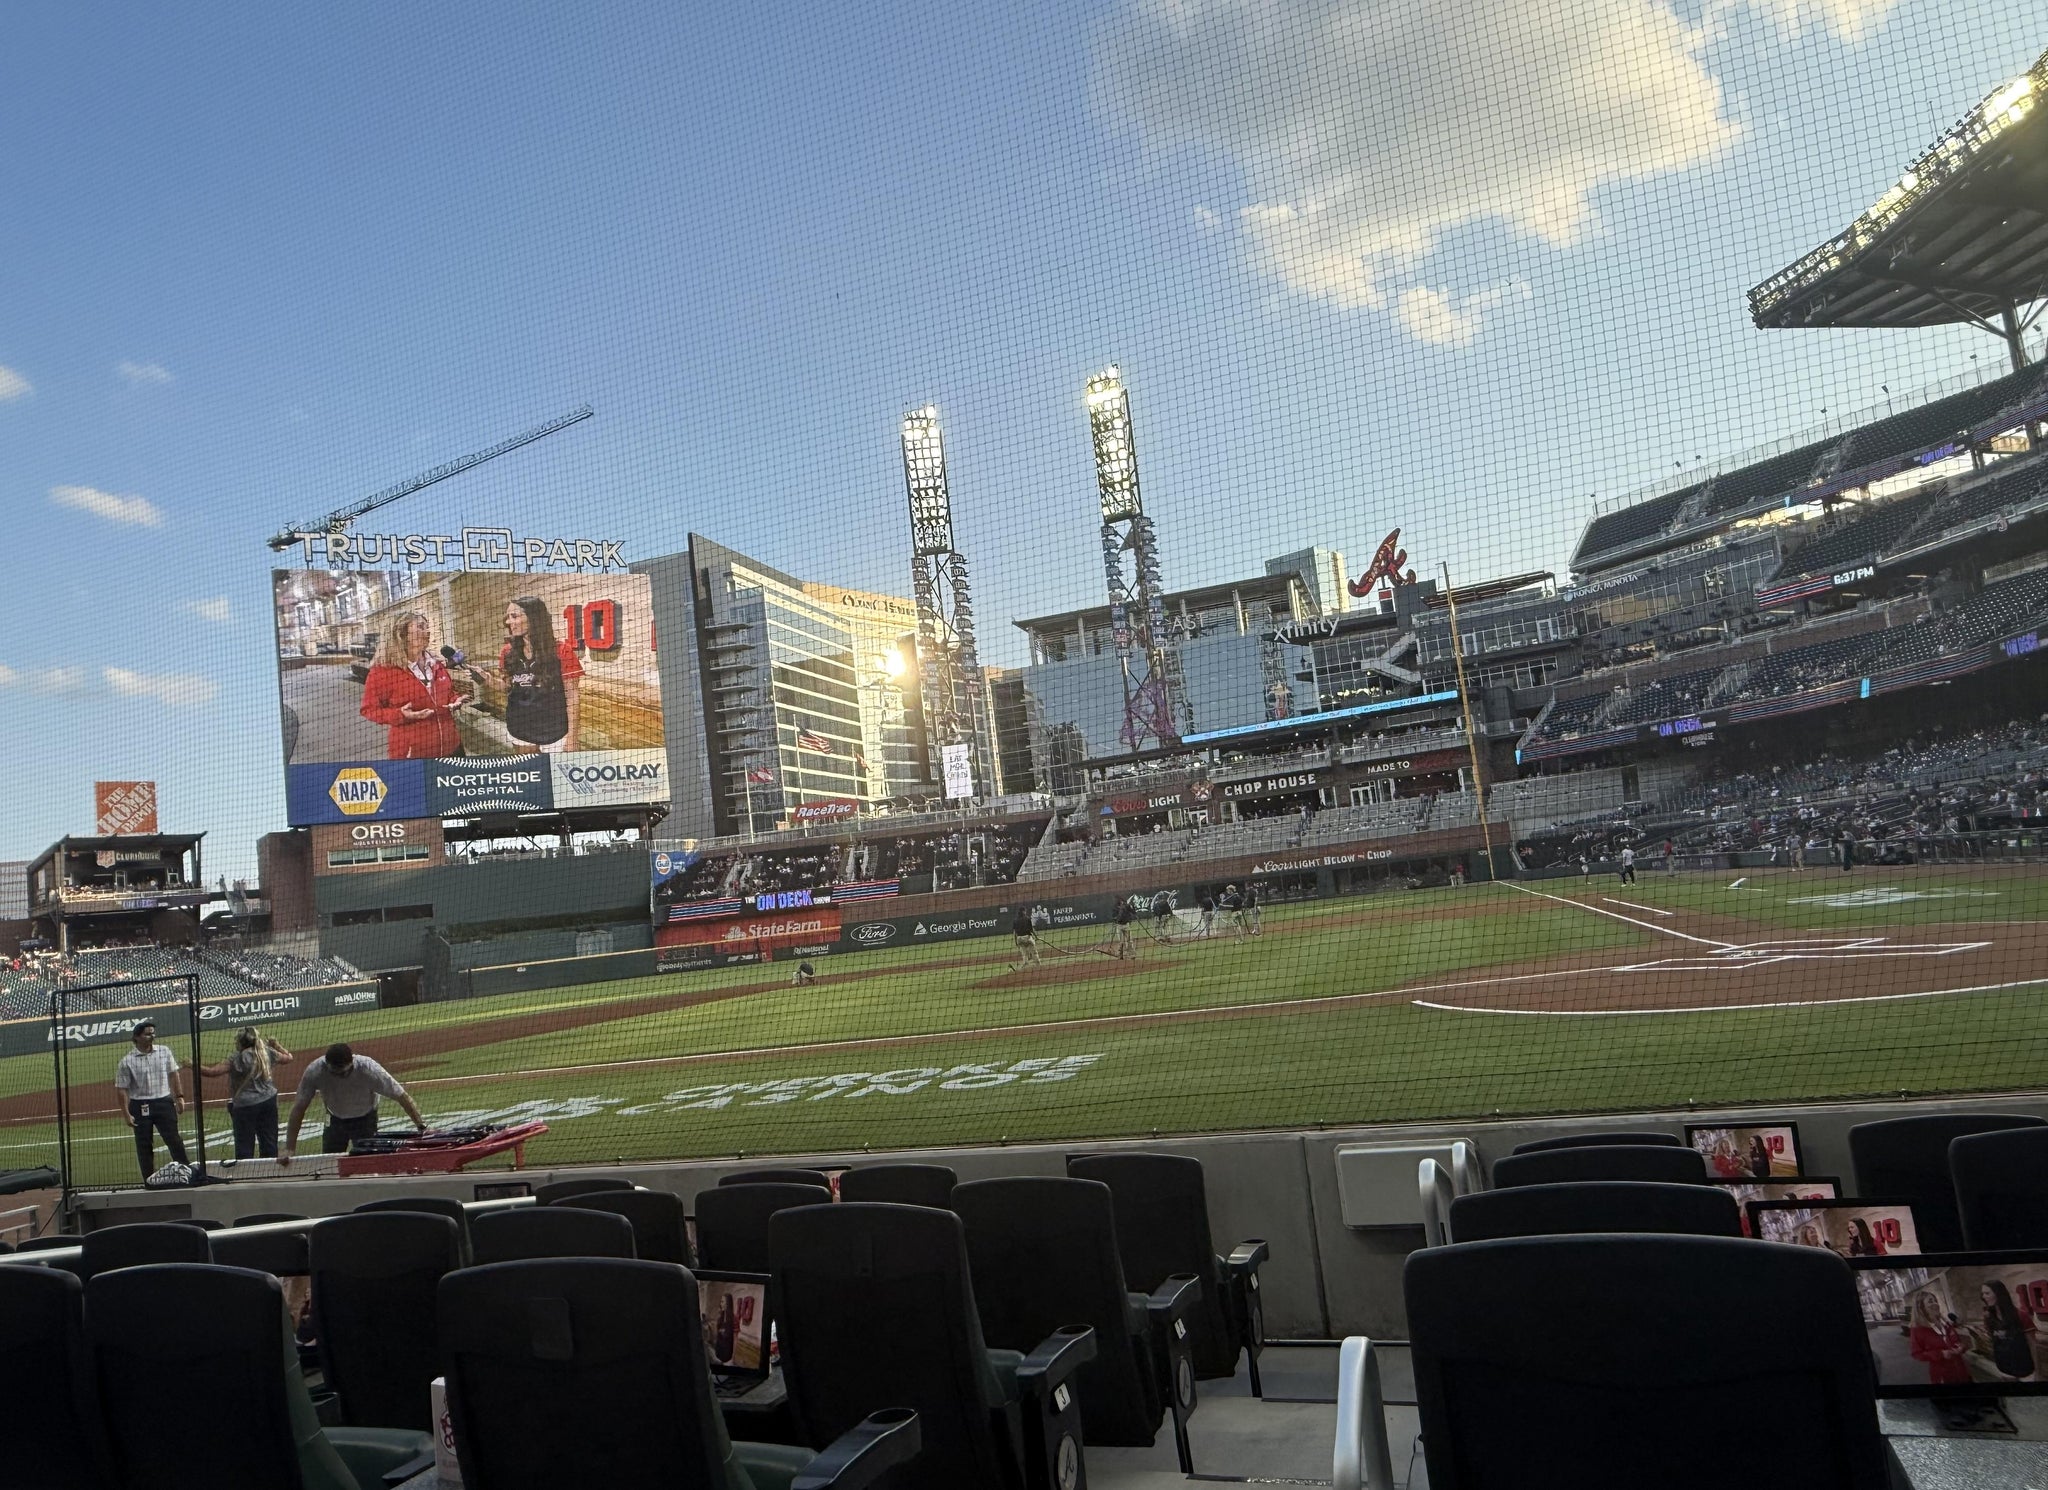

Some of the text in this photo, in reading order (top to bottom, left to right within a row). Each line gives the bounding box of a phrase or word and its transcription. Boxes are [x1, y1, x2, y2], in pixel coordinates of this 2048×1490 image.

[294, 531, 628, 568] TRUIST PARK
[1834, 565, 1875, 585] 6:37 PM
[563, 598, 621, 651] 10
[1273, 616, 1340, 644] xfinity
[568, 763, 662, 784] COOLRAY
[1367, 762, 1396, 775] MADE
[1397, 760, 1411, 770] TO
[436, 770, 542, 788] NORTHSIDE
[1224, 773, 1317, 797] CHOP HOUSE
[339, 780, 379, 802] NAPA
[457, 785, 524, 798] HOSPITAL
[796, 803, 853, 818] RaceTrac
[1148, 794, 1182, 809] LIGHT
[351, 823, 406, 840] ORIS
[1292, 858, 1322, 869] LIGHT
[1366, 850, 1393, 861] CHOP
[756, 893, 777, 912] ON
[777, 889, 814, 909] DECK
[858, 925, 888, 940] Ford
[929, 918, 999, 934] Georgia Power
[227, 996, 300, 1016] HYUNDAI
[47, 1016, 151, 1042] EQUIFAX
[663, 1053, 1108, 1103] CHEROKEE
[615, 1067, 1083, 1117] CASINOS
